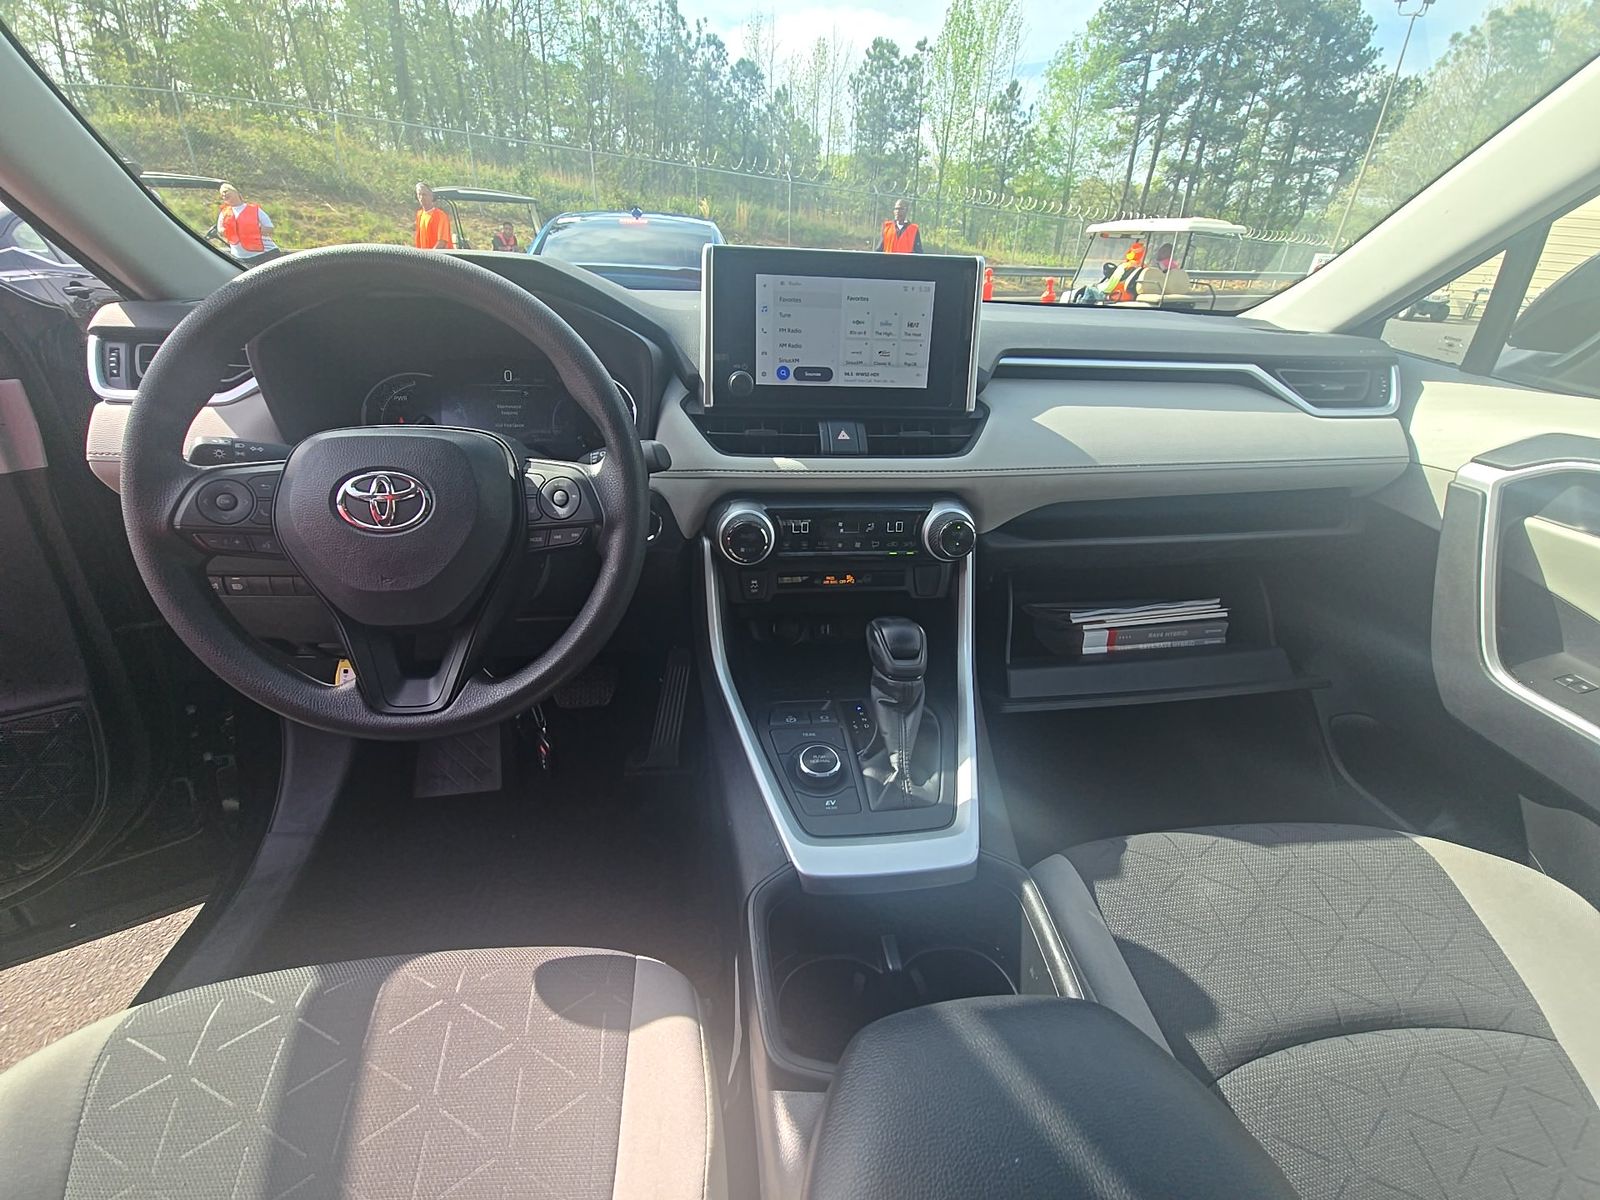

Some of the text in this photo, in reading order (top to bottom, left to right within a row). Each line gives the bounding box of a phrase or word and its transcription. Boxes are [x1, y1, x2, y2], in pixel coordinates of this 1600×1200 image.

[503, 370, 512, 382] 0
[886, 521, 904, 533] LO
[1164, 630, 1188, 638] HYBRID
